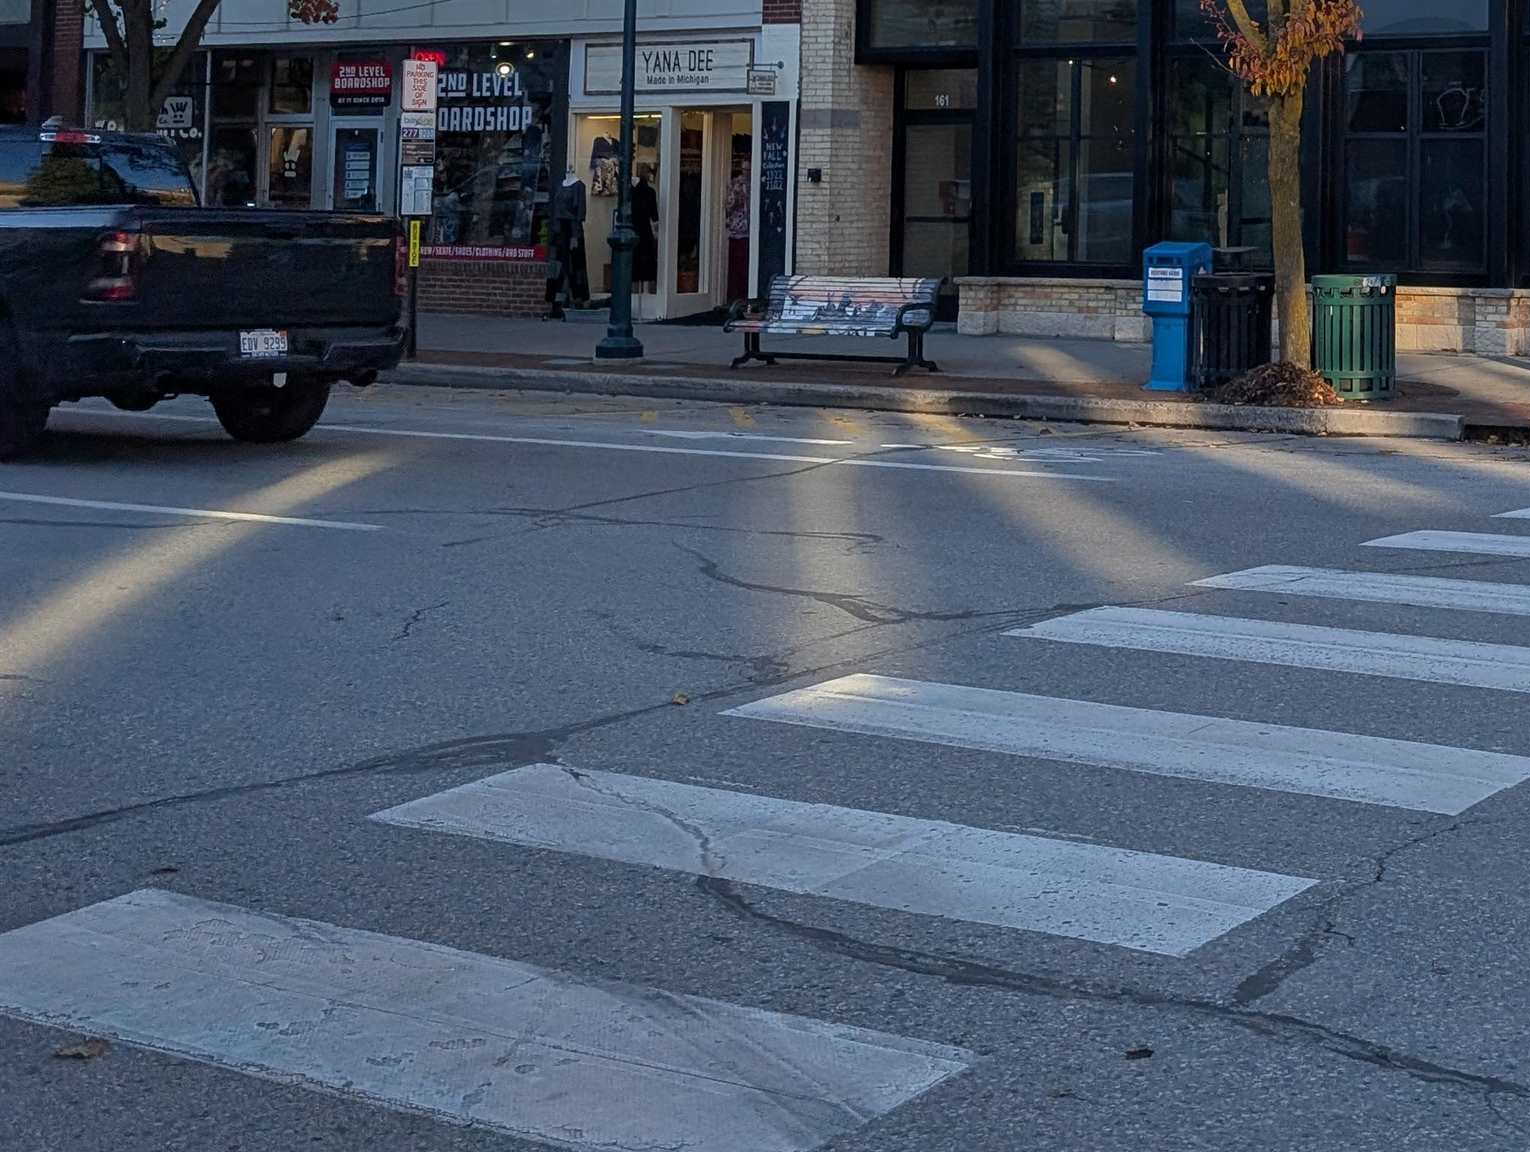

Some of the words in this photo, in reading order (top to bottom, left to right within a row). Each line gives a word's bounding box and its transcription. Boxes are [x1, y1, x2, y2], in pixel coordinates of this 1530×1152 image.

[642, 51, 681, 73] YANA
[688, 50, 713, 72] DEE
[339, 66, 355, 77] 2ND
[358, 66, 385, 77] LEVEL
[407, 70, 434, 78] PARKING
[335, 78, 390, 88] BOARDSHOP
[437, 73, 467, 97] 2ND
[473, 72, 522, 96] LEVEL
[647, 75, 666, 84] Made
[668, 75, 675, 84] in
[677, 74, 709, 85] Michigan
[935, 95, 949, 106] 161
[438, 106, 532, 133] OARDSHOP
[402, 129, 417, 137] 277
